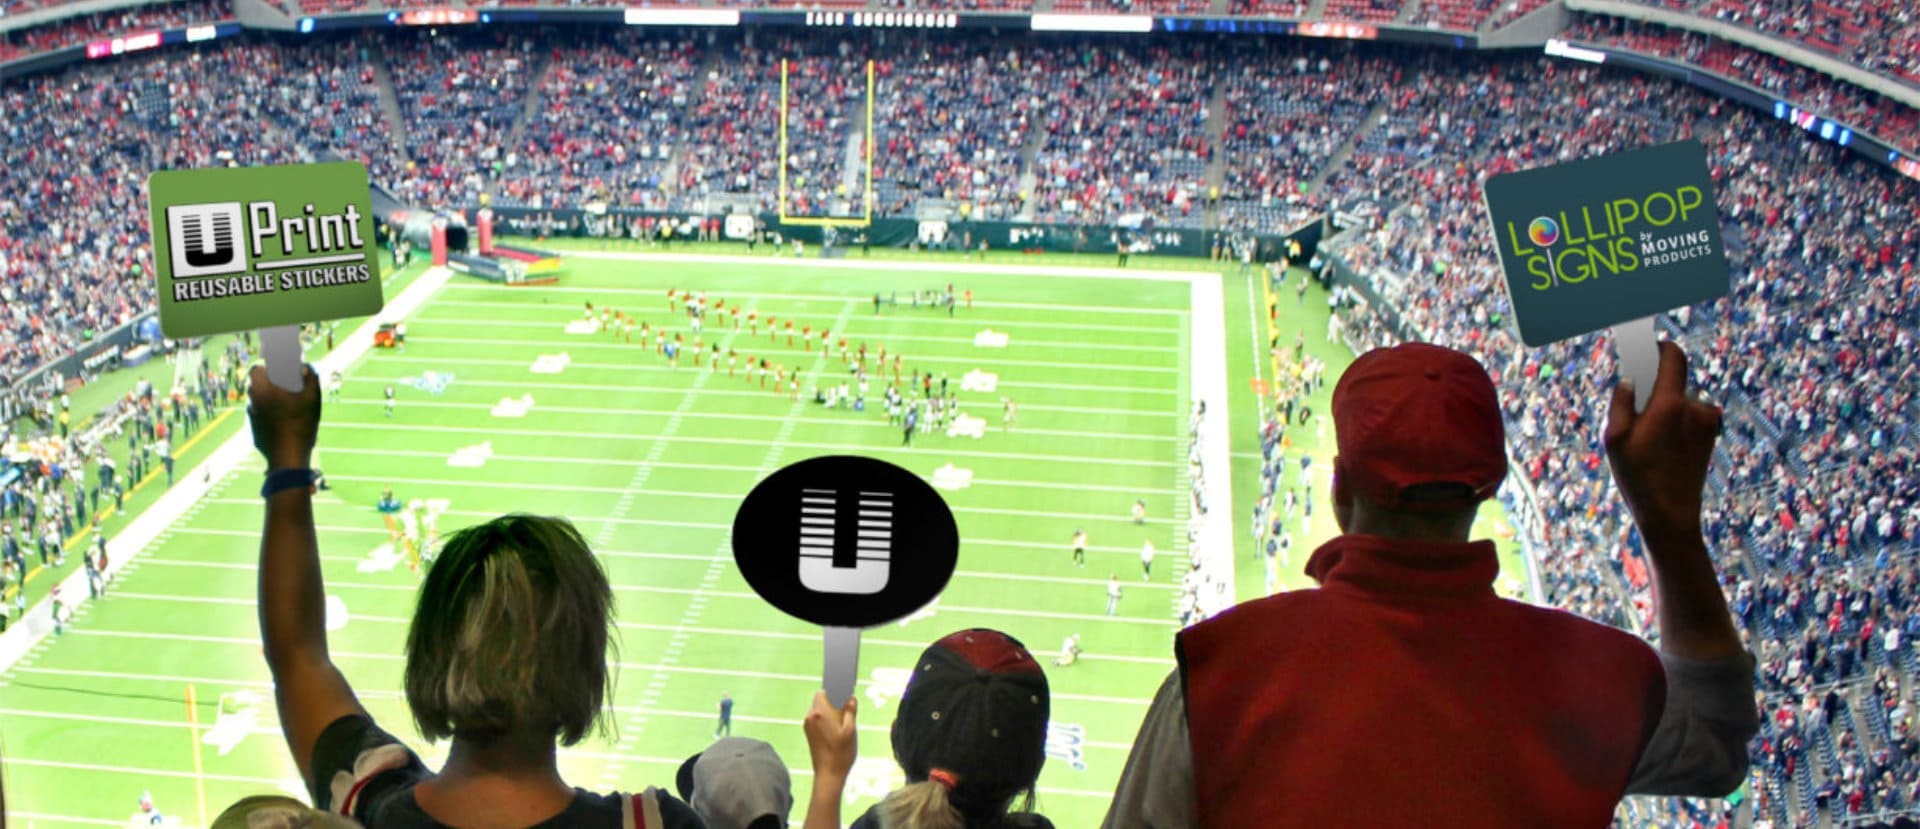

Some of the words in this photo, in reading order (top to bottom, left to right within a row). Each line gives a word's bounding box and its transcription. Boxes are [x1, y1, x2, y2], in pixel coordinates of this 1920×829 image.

[181, 212, 234, 268] U
[249, 201, 364, 256] Print
[1507, 185, 1703, 257] LOLLIPOP
[1640, 231, 1653, 242] by
[1641, 229, 1710, 256] MOVING
[1527, 236, 1639, 291] SIGNS
[1644, 244, 1712, 268] PRODUCTS
[174, 273, 275, 301] REUSABLE
[281, 264, 370, 290] STICKERS
[798, 488, 894, 595] U
